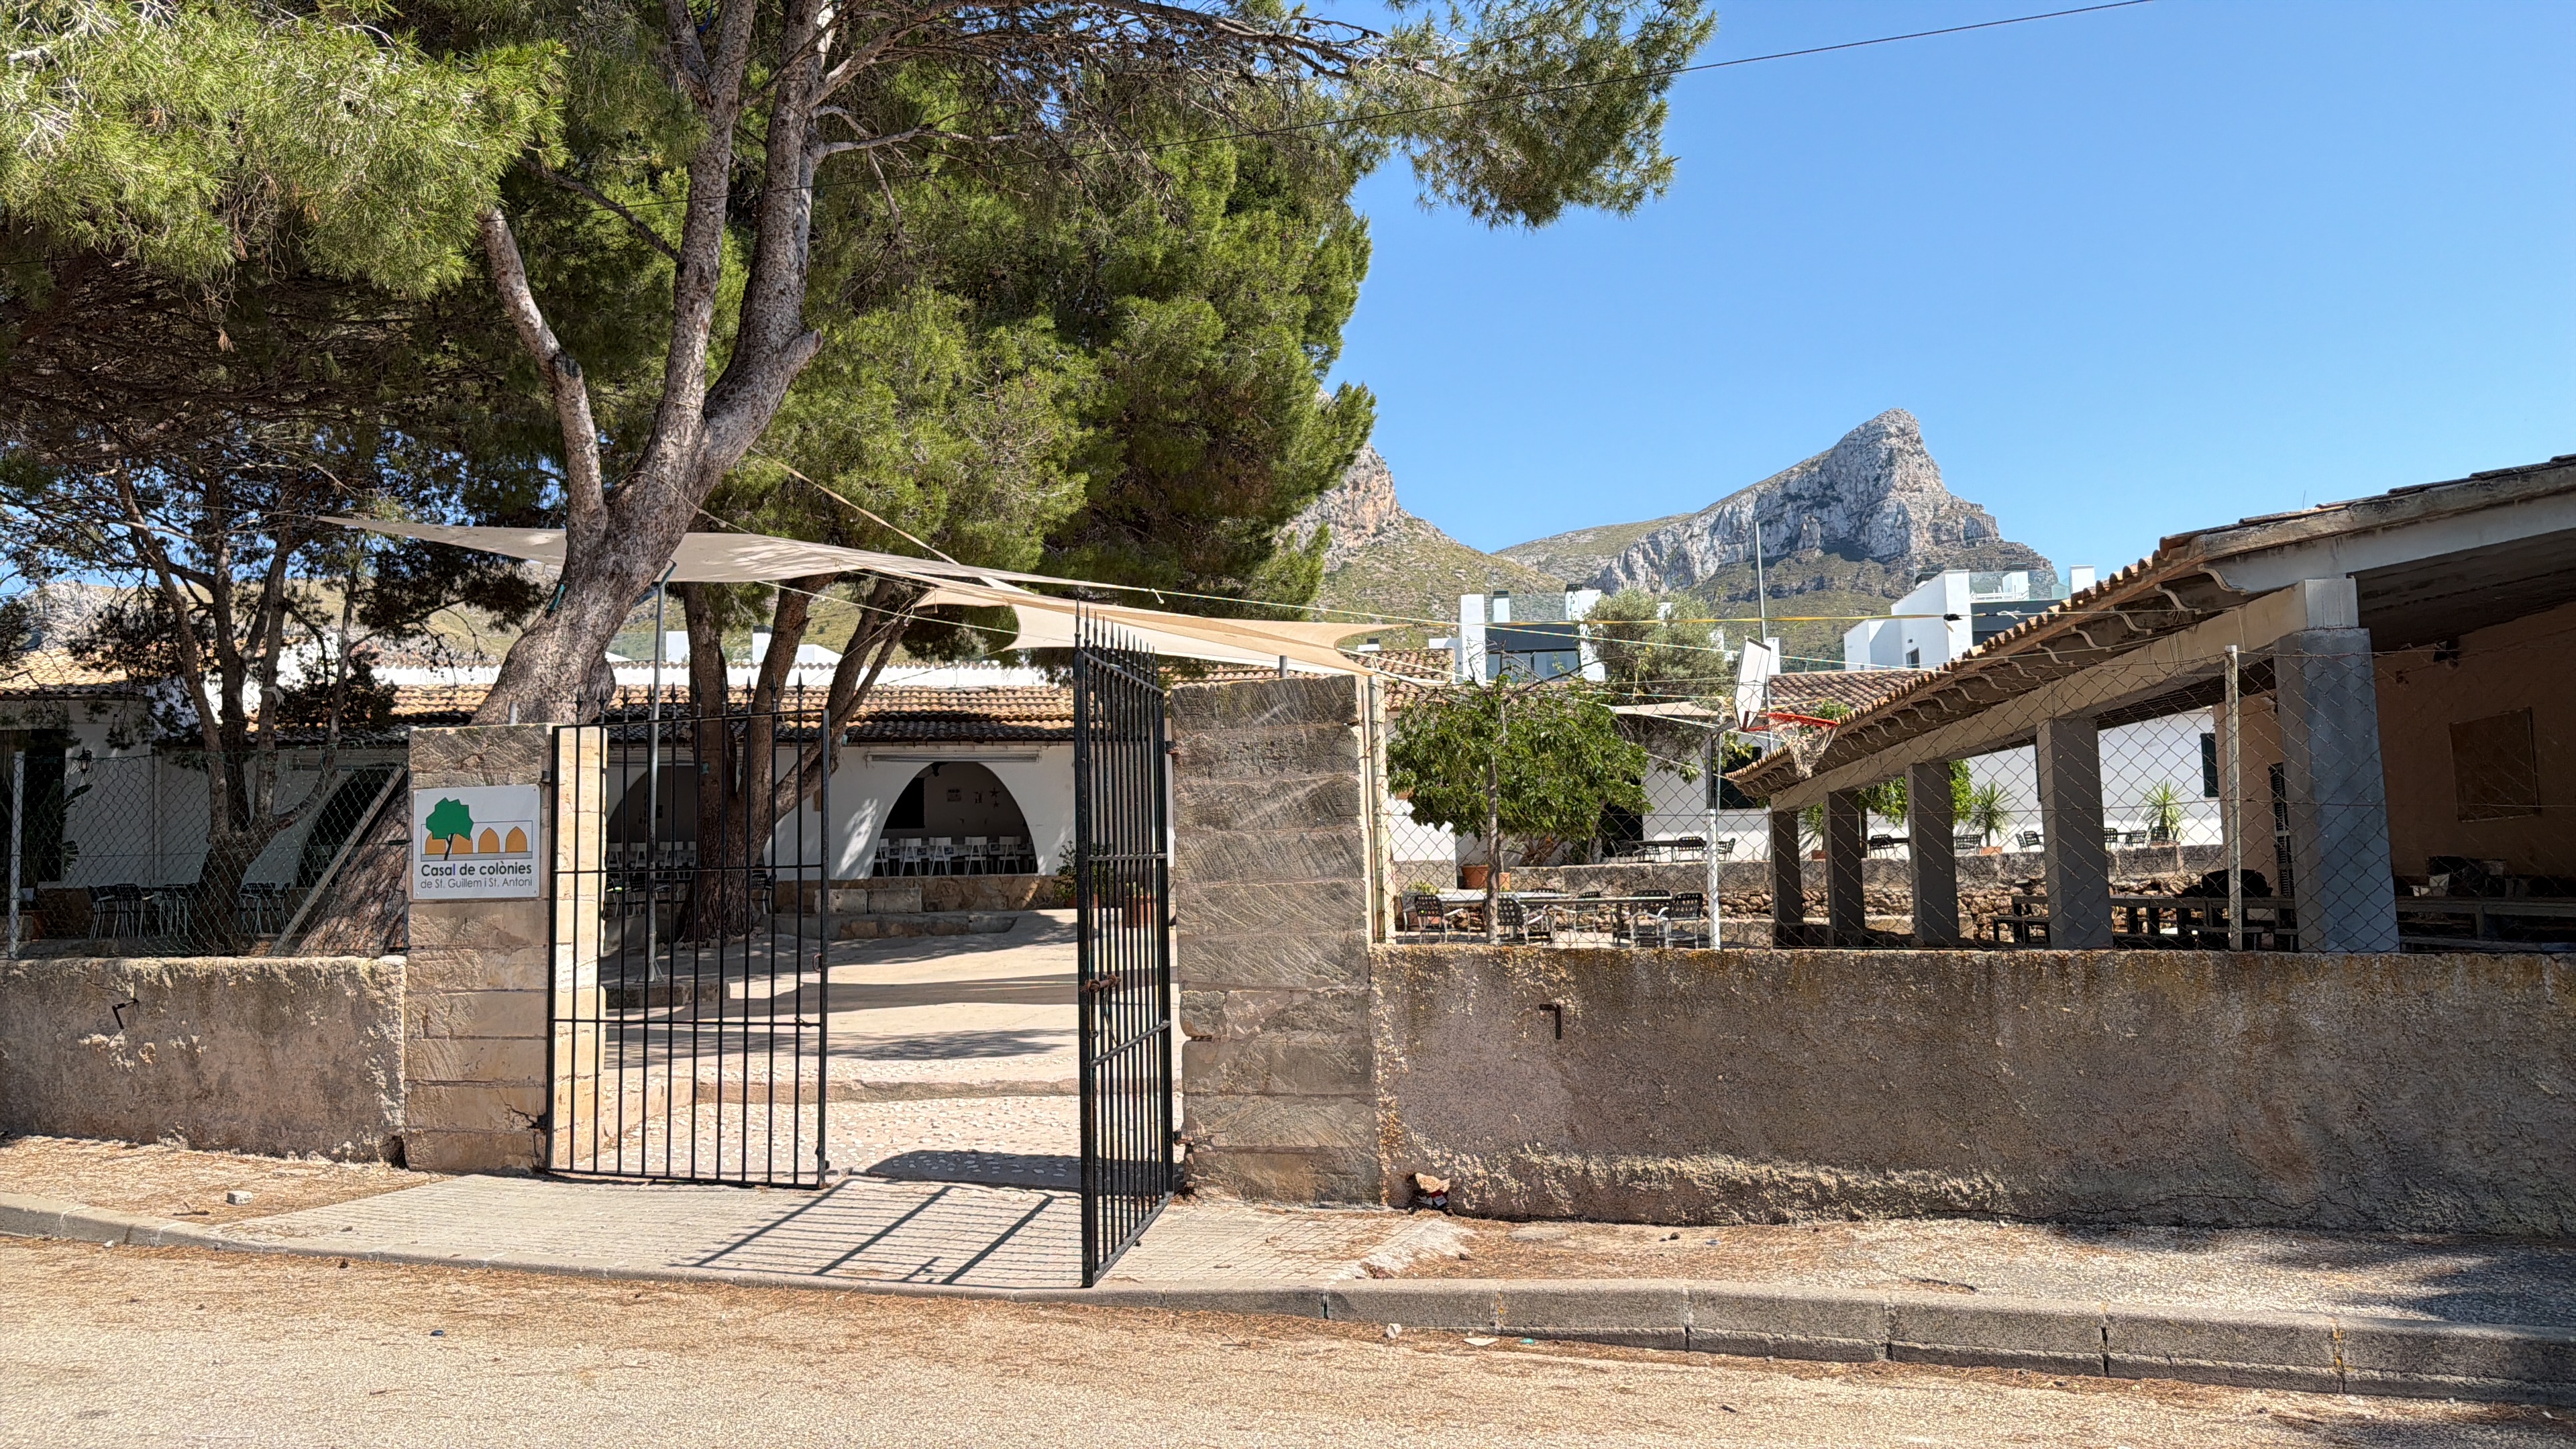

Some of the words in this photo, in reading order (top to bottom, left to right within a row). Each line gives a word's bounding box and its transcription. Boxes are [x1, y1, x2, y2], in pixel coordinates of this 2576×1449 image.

[421, 863, 455, 876] Casal
[460, 863, 476, 875] de
[479, 861, 532, 875] colònies
[420, 879, 433, 889] de
[435, 878, 446, 888] St.
[447, 877, 482, 888] Guillem
[488, 877, 500, 888] St.
[502, 877, 533, 887] Antoni
